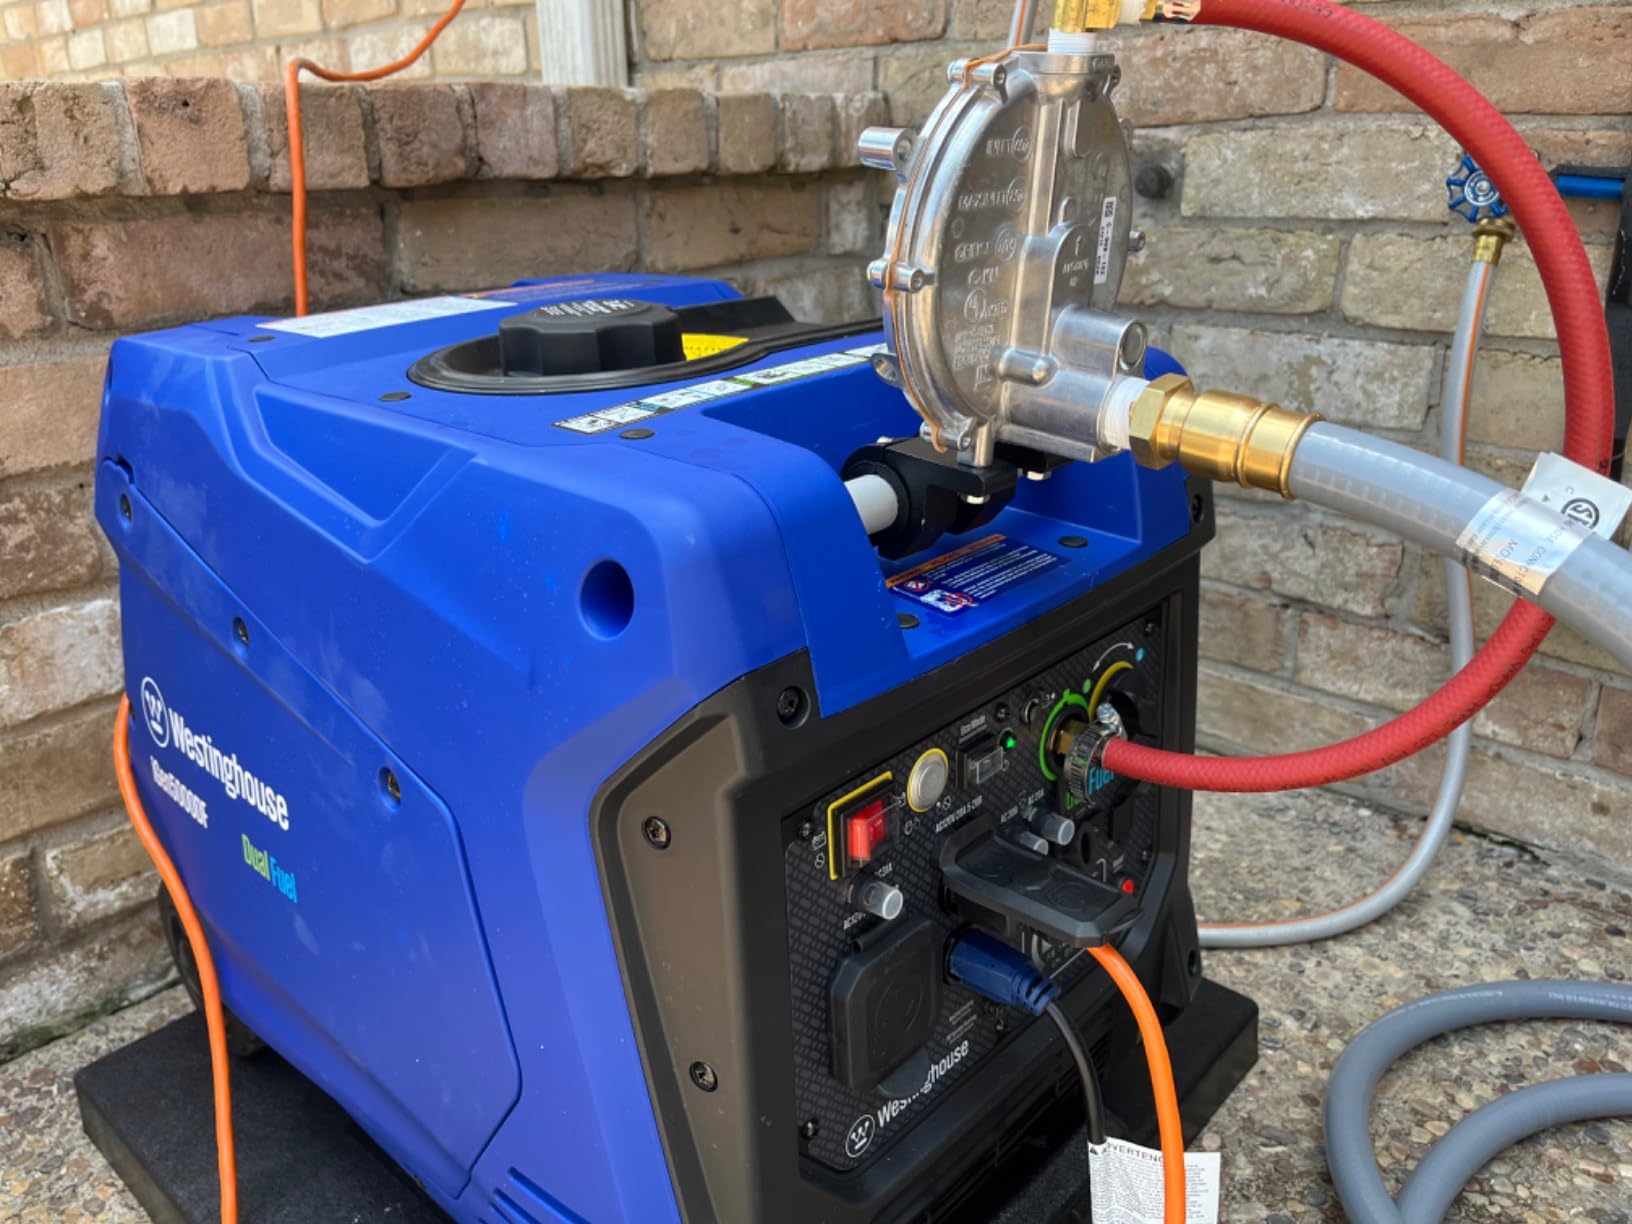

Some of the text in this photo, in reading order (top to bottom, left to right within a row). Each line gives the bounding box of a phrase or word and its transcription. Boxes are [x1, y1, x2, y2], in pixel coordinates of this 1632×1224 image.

[168, 708, 289, 831] Westinghouse
[1087, 766, 1115, 796] Fue
[878, 1039, 969, 1128] Wesghouse
